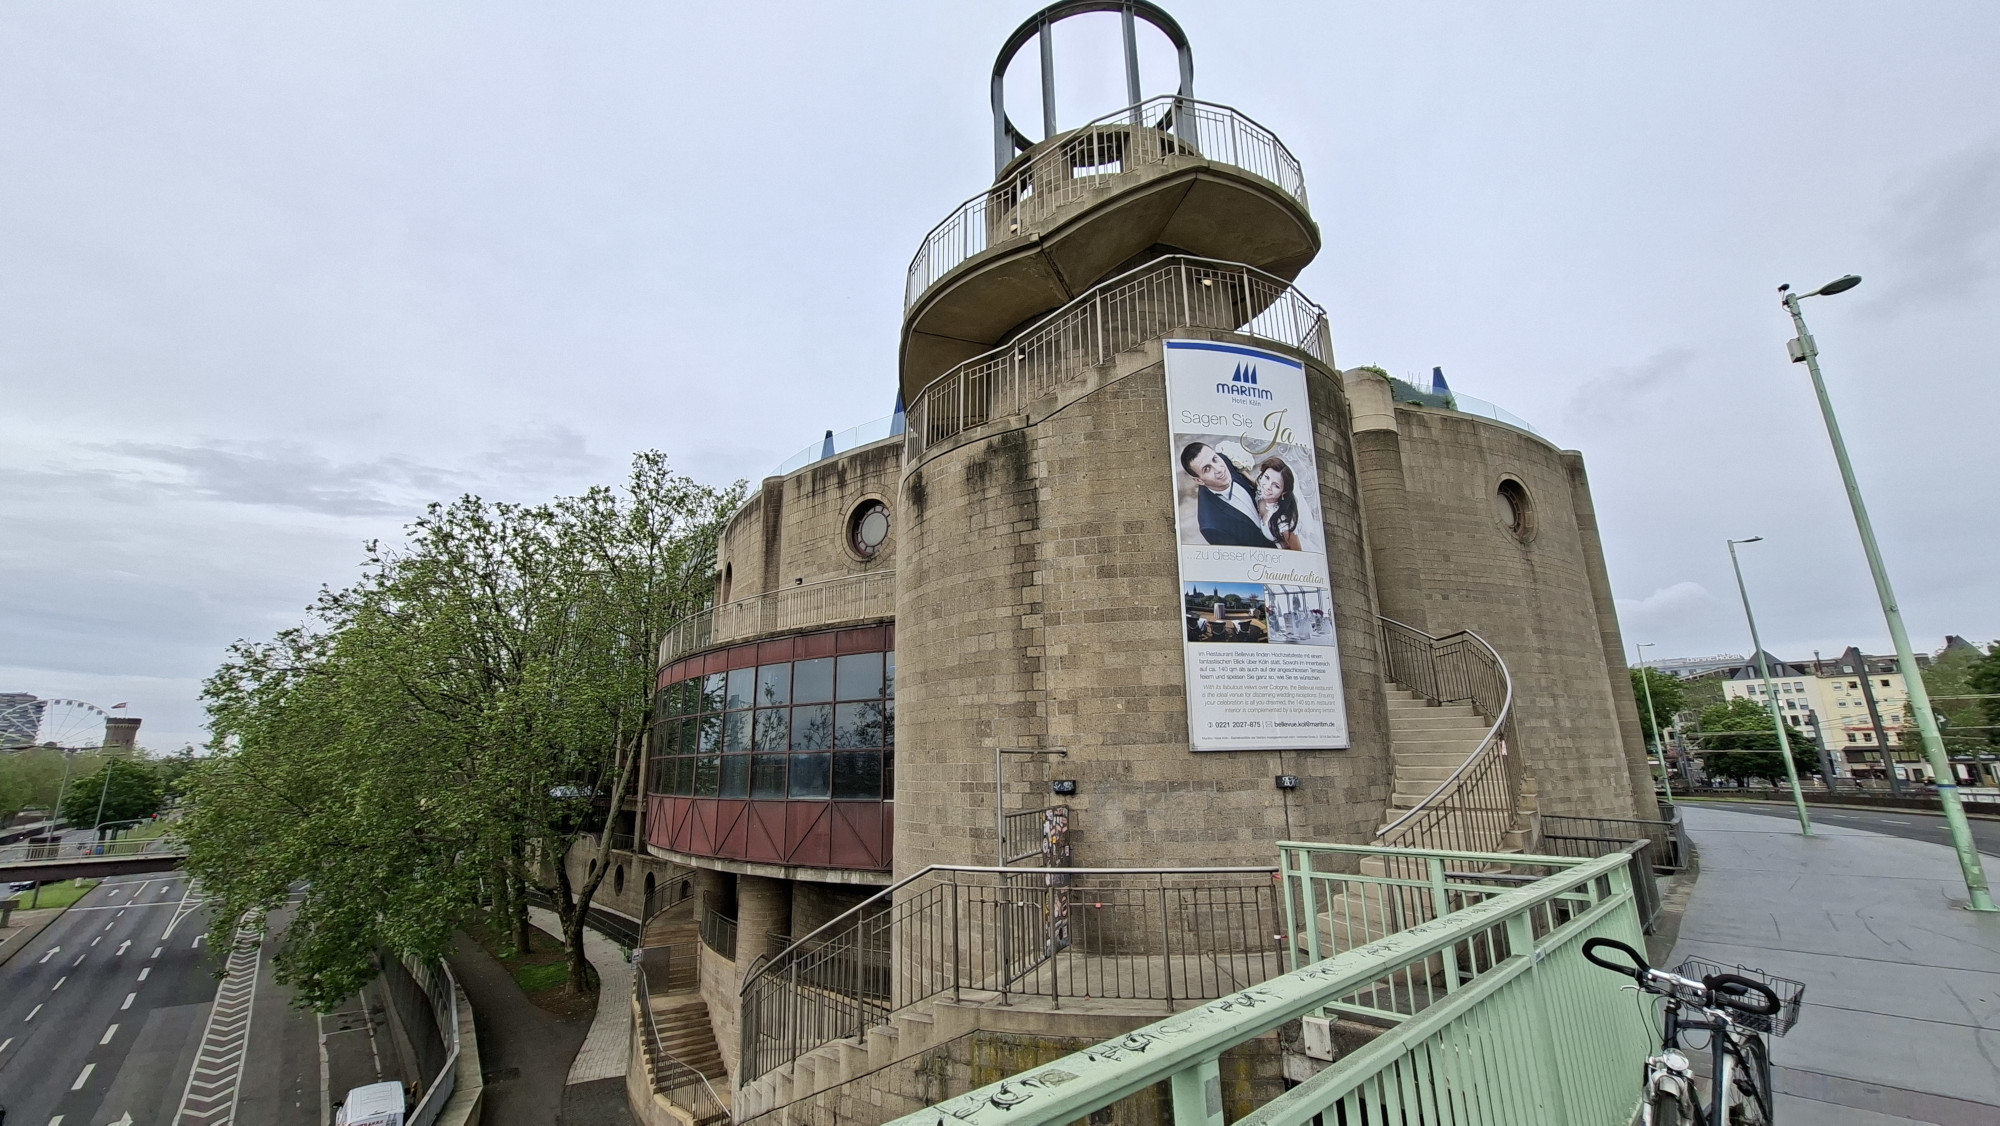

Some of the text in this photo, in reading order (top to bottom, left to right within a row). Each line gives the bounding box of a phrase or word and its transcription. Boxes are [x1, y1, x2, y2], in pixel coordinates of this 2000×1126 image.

[1216, 383, 1273, 400] MARITIM
[1232, 397, 1262, 407] Hotel Köln
[1181, 410, 1228, 428] Sagen
[1232, 413, 1253, 428] Sie
[1212, 549, 1246, 562] dieser
[1250, 550, 1282, 564] Kölner
[1247, 564, 1324, 585] Traumlocation
